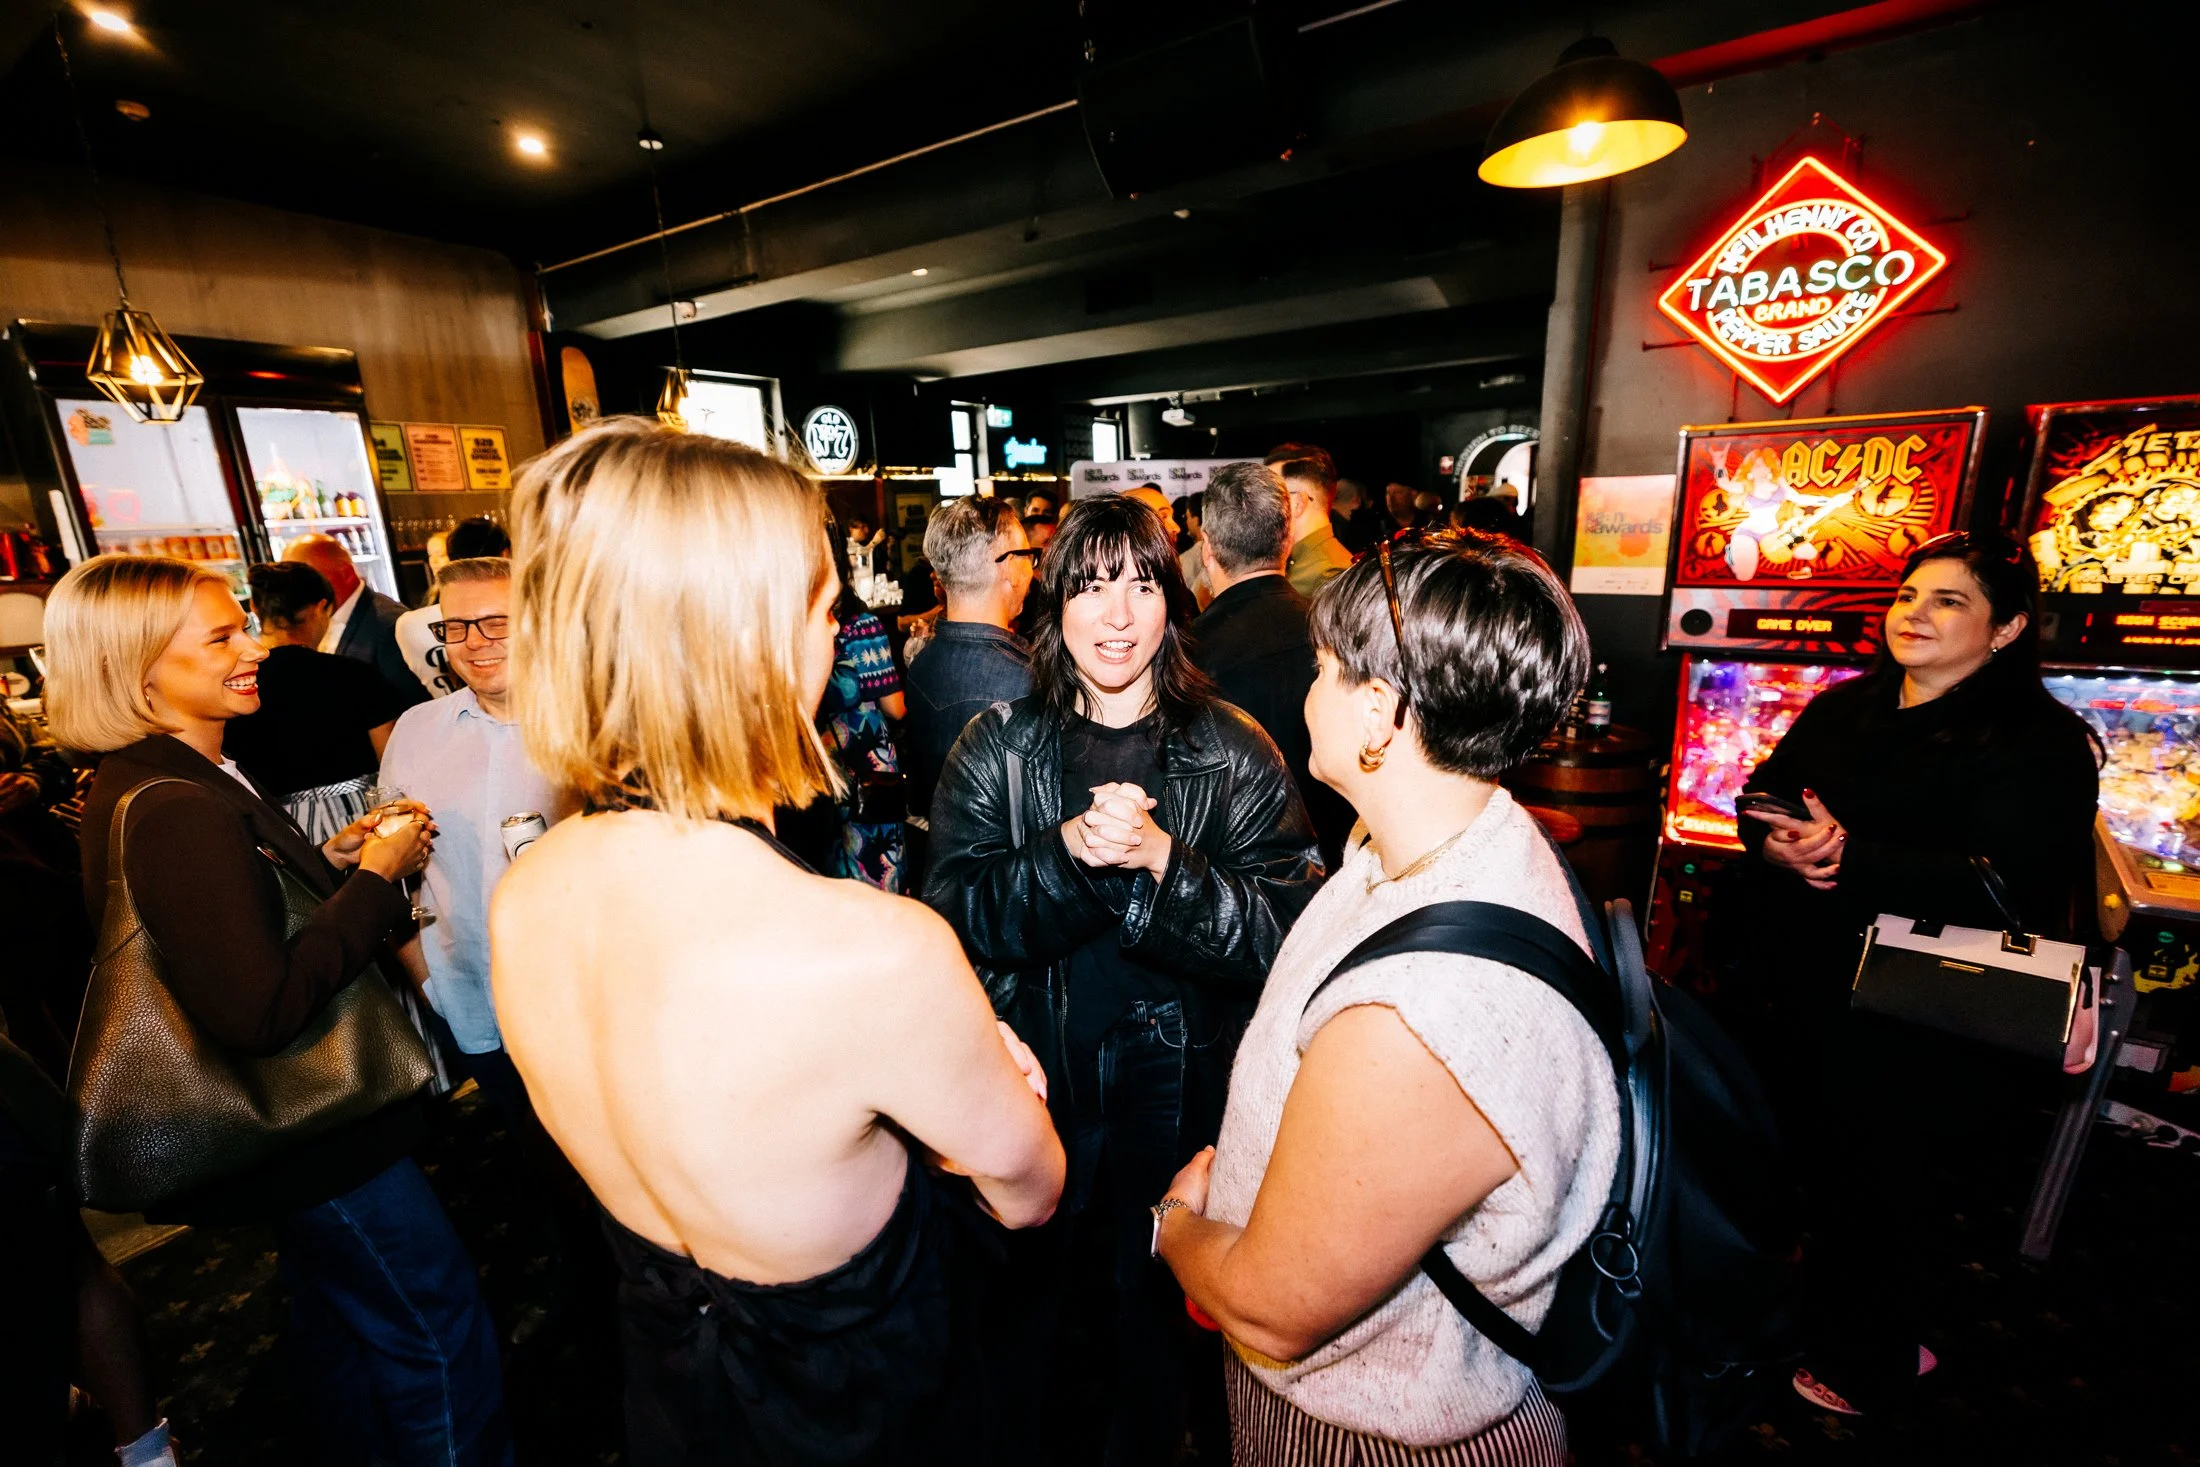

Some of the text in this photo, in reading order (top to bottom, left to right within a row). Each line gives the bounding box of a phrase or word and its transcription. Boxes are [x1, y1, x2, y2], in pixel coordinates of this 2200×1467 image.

[1687, 249, 1915, 311] TABASCO
[1752, 295, 1833, 323] BRAND
[1713, 290, 1877, 356] PEPPER SAUCE
[1594, 518, 1664, 535] awards
[2079, 573, 2199, 585] MASTER OF
[1756, 618, 1833, 632] GAME OVER
